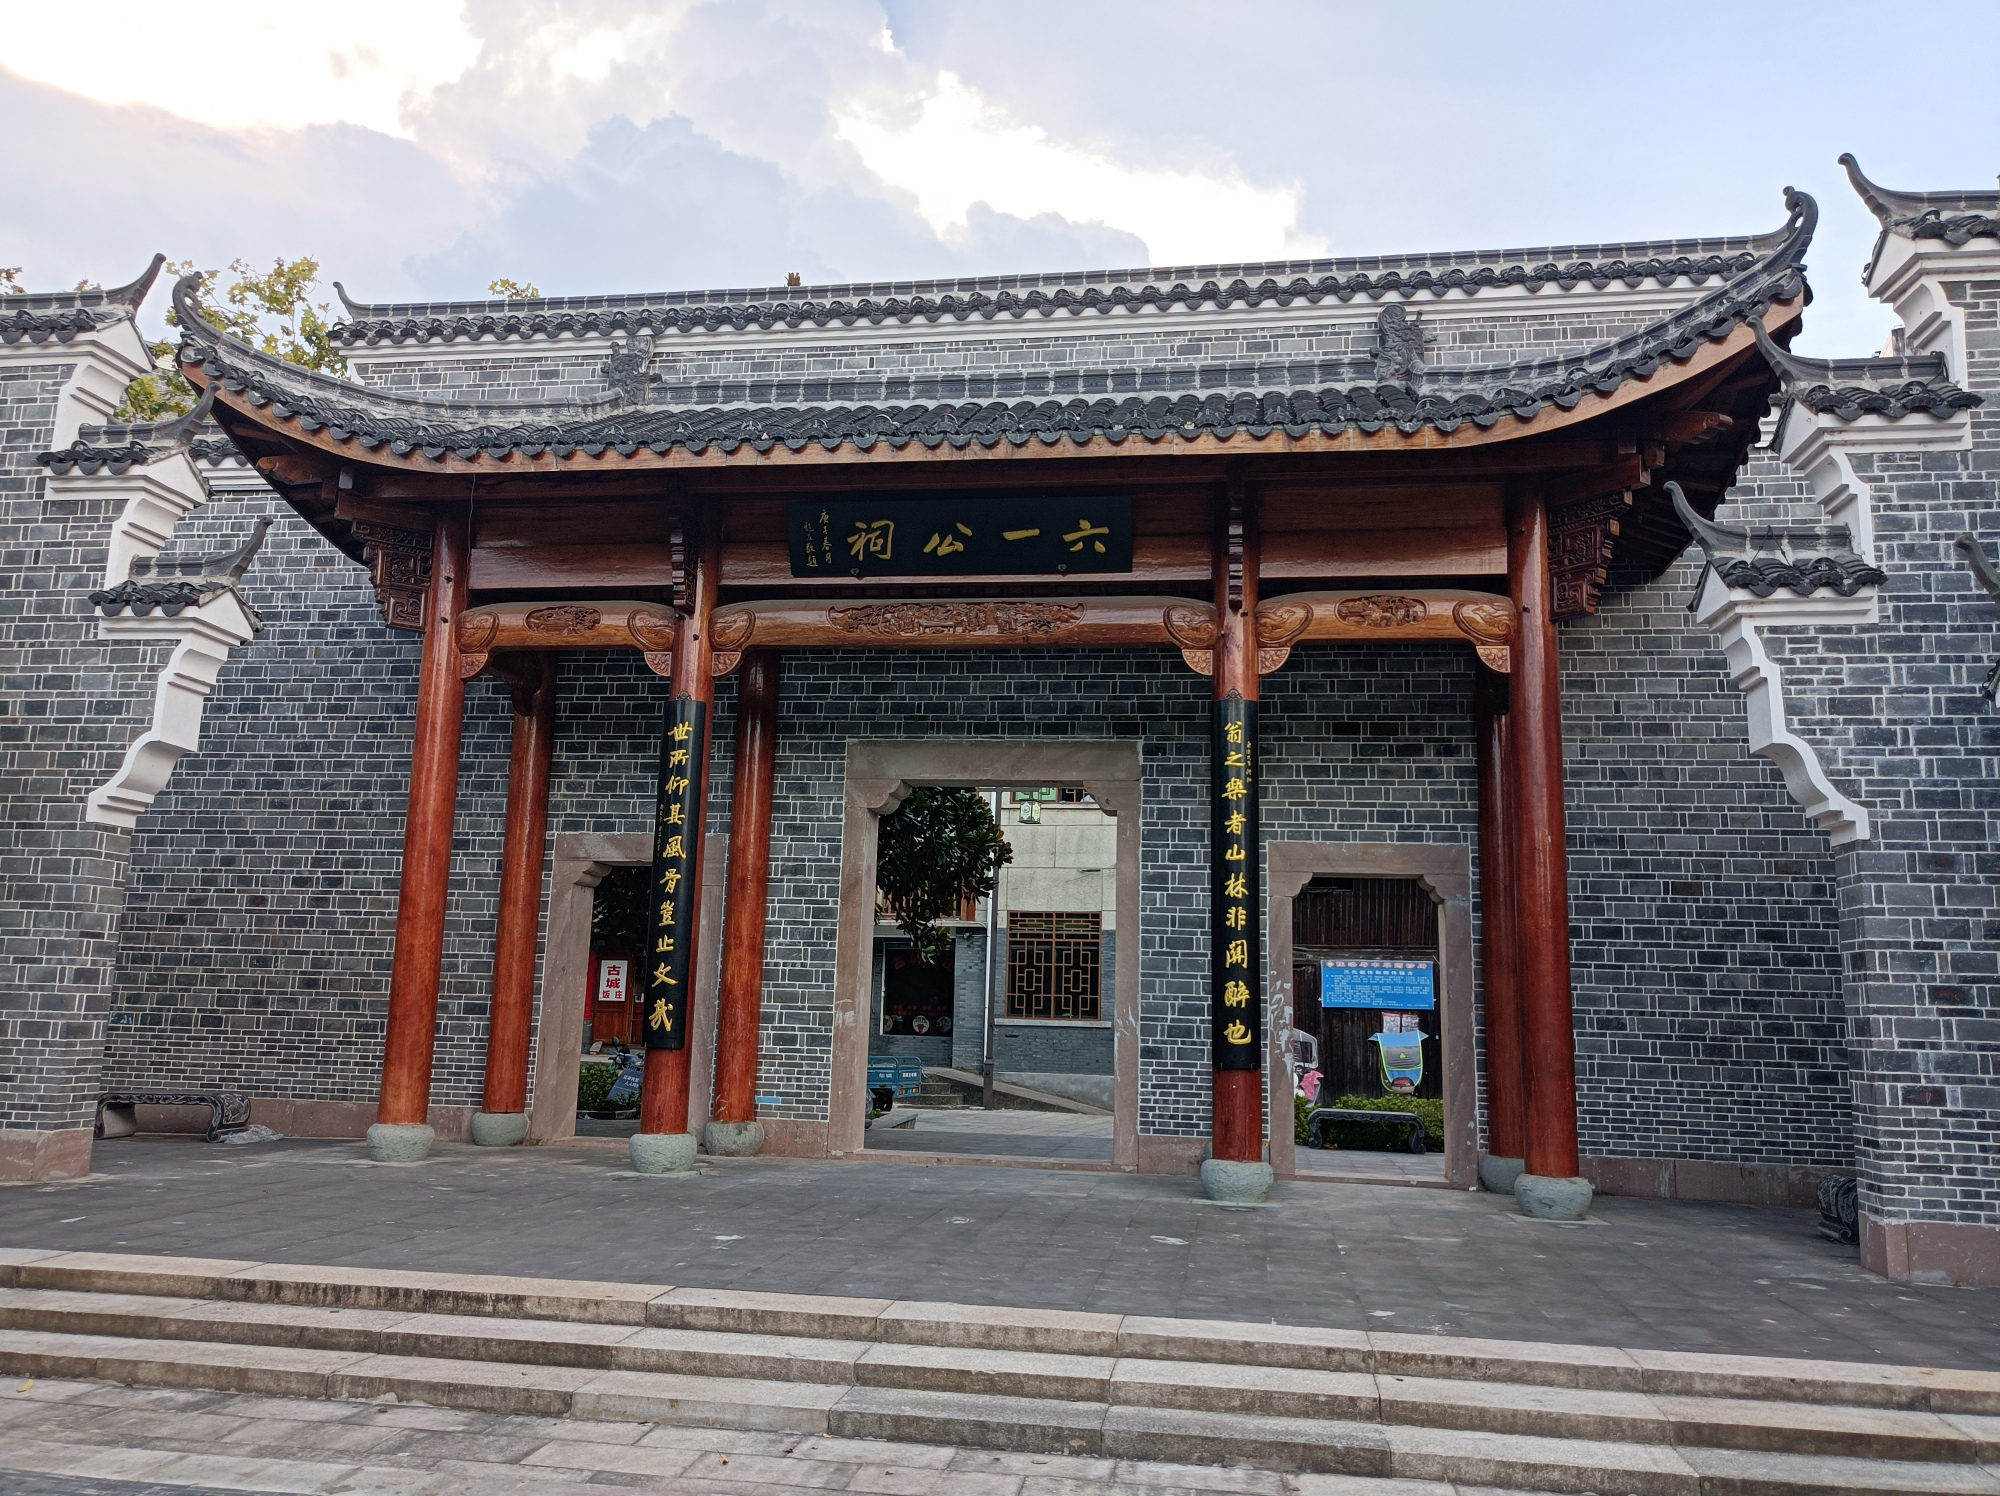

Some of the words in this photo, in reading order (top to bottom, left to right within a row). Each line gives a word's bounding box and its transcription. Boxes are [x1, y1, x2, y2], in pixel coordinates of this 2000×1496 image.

[847, 519, 1110, 561] 六一公祠
[605, 964, 622, 989] 古城
[602, 990, 624, 999] 饭庄
